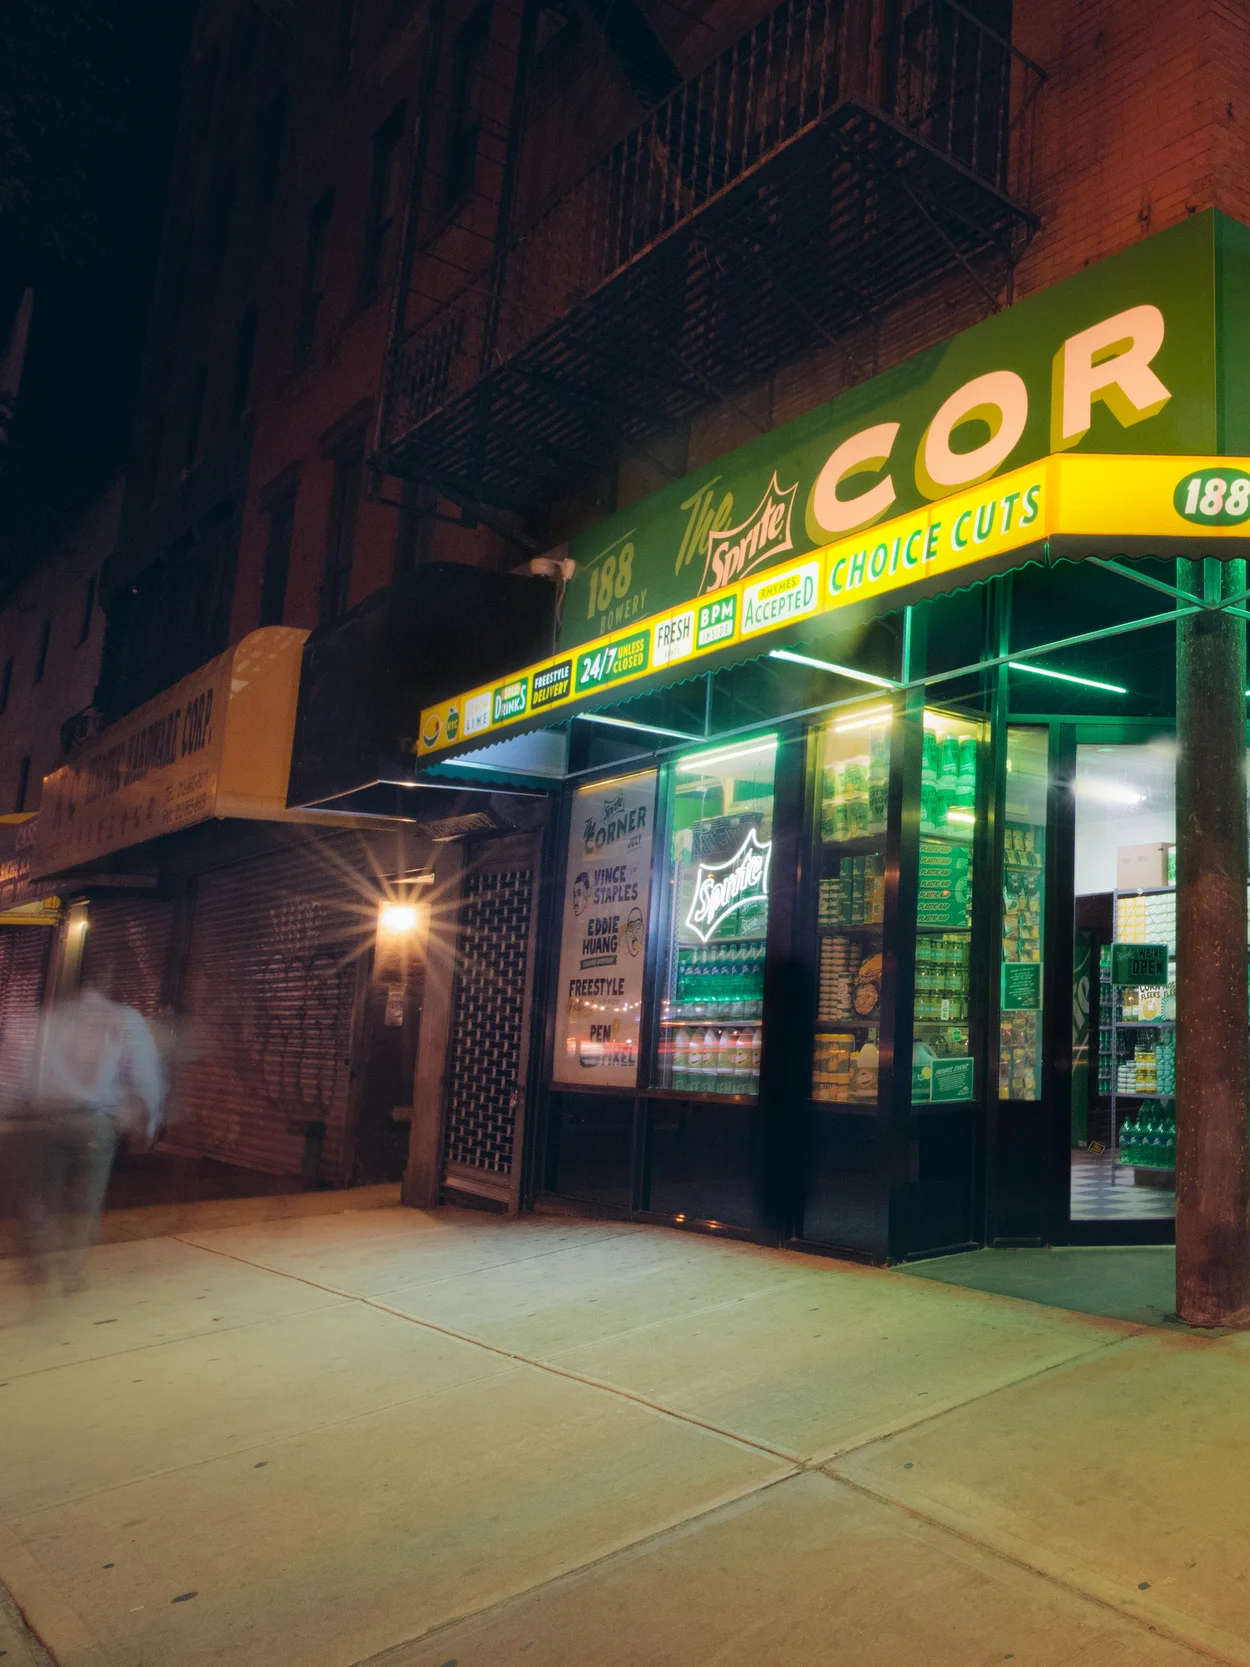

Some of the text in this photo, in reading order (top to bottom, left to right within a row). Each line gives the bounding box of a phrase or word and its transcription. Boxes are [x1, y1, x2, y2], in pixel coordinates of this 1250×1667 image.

[675, 475, 733, 577] The
[707, 494, 785, 593] Sprite
[829, 484, 1041, 596] CHOICE CUTS
[587, 541, 635, 620] 188
[761, 577, 797, 598] RHYMES
[600, 588, 647, 634] BOWERY
[700, 599, 734, 628] BPM
[658, 615, 691, 648] FRESH
[702, 623, 730, 642] INSIDE
[617, 638, 645, 660] UNLESS
[580, 647, 618, 684] 24/7
[612, 652, 644, 674] CLOSED
[534, 665, 569, 689] FREESTYLE
[494, 684, 527, 719] DRINKS
[533, 679, 569, 704] DELIVERY
[466, 712, 487, 730] LIME
[585, 806, 647, 854] CORNER
[594, 865, 627, 885] VINCE
[695, 848, 763, 925] Sprite
[593, 883, 639, 905] STAPLES
[587, 916, 620, 937] EDDIE
[582, 935, 618, 955] HUANG
[1132, 959, 1163, 976] OPEN
[568, 978, 625, 997] FREESTYLE
[590, 1024, 611, 1042] PEN
